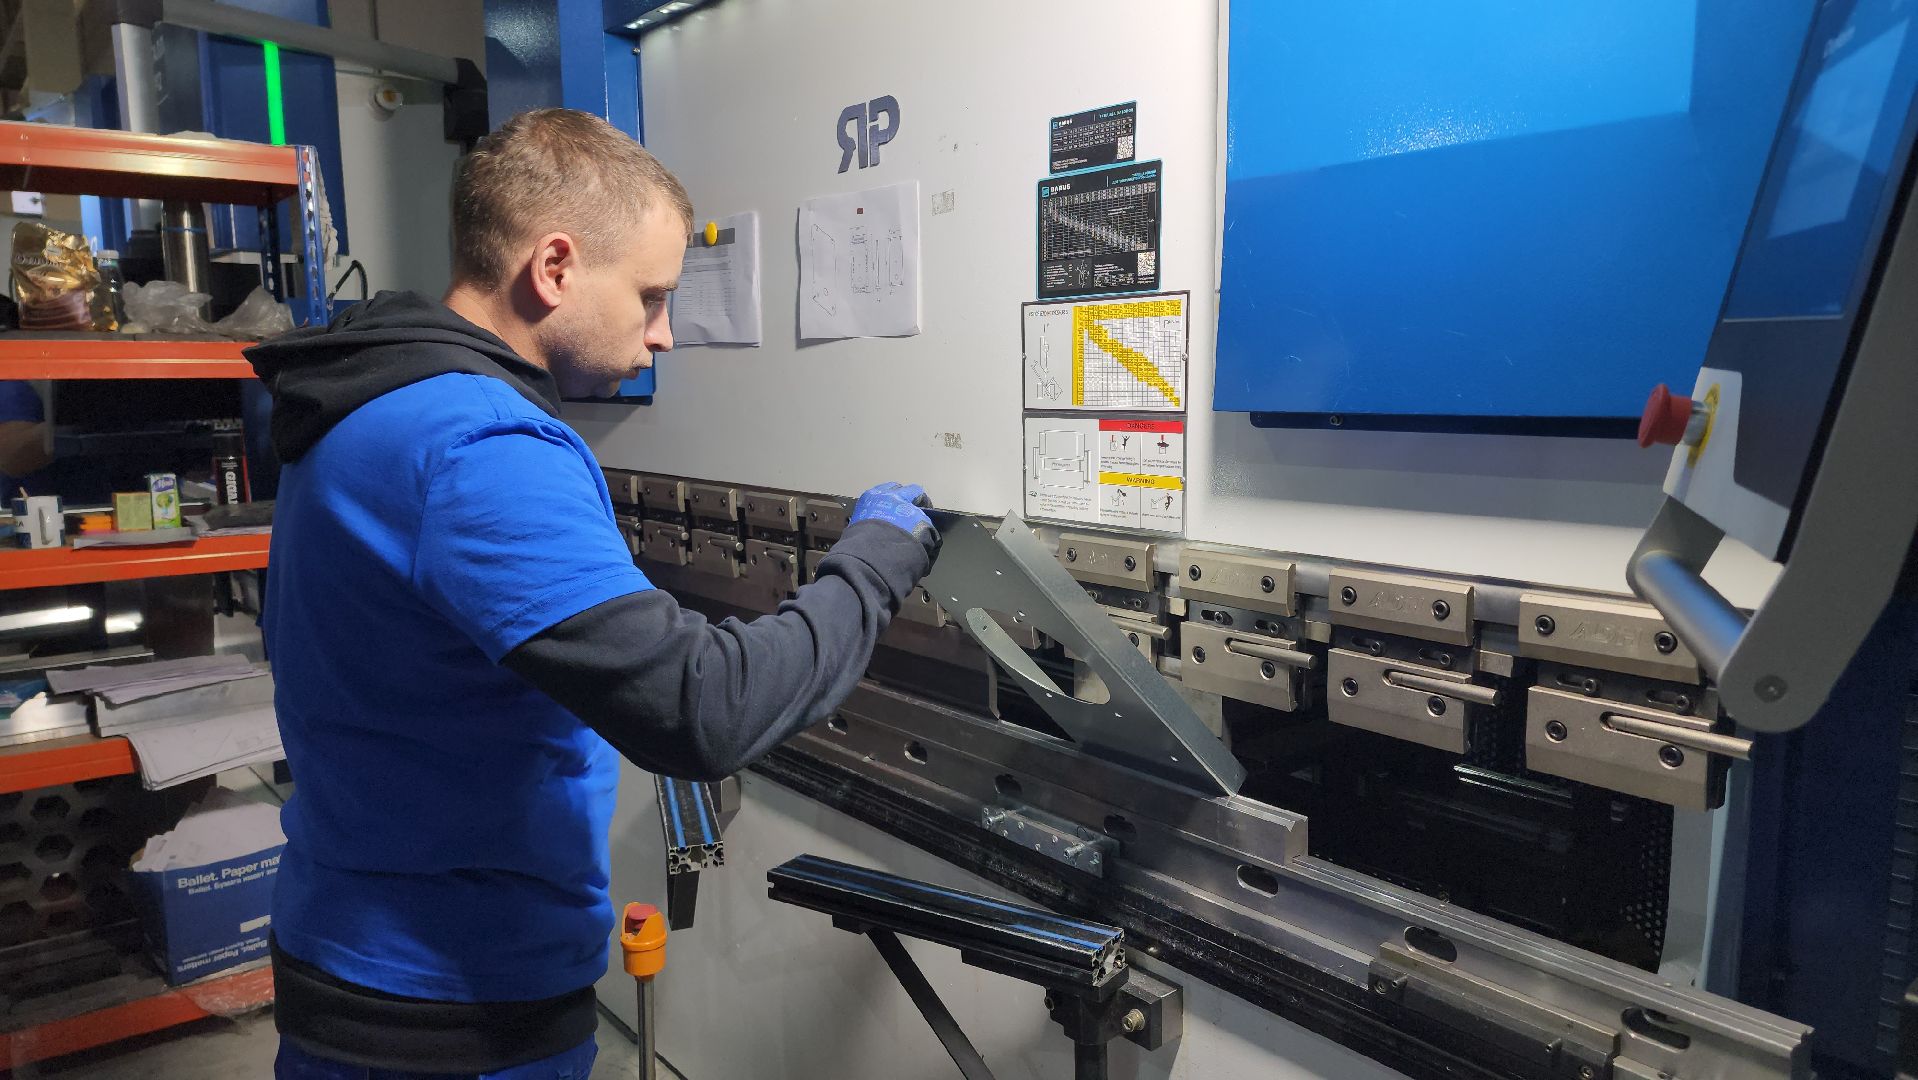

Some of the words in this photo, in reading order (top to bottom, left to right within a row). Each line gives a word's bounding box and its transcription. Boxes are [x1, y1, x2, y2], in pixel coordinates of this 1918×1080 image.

[1126, 476, 1155, 485] WARNING
[177, 872, 219, 889] Ballet.
[221, 862, 258, 879] Paper
